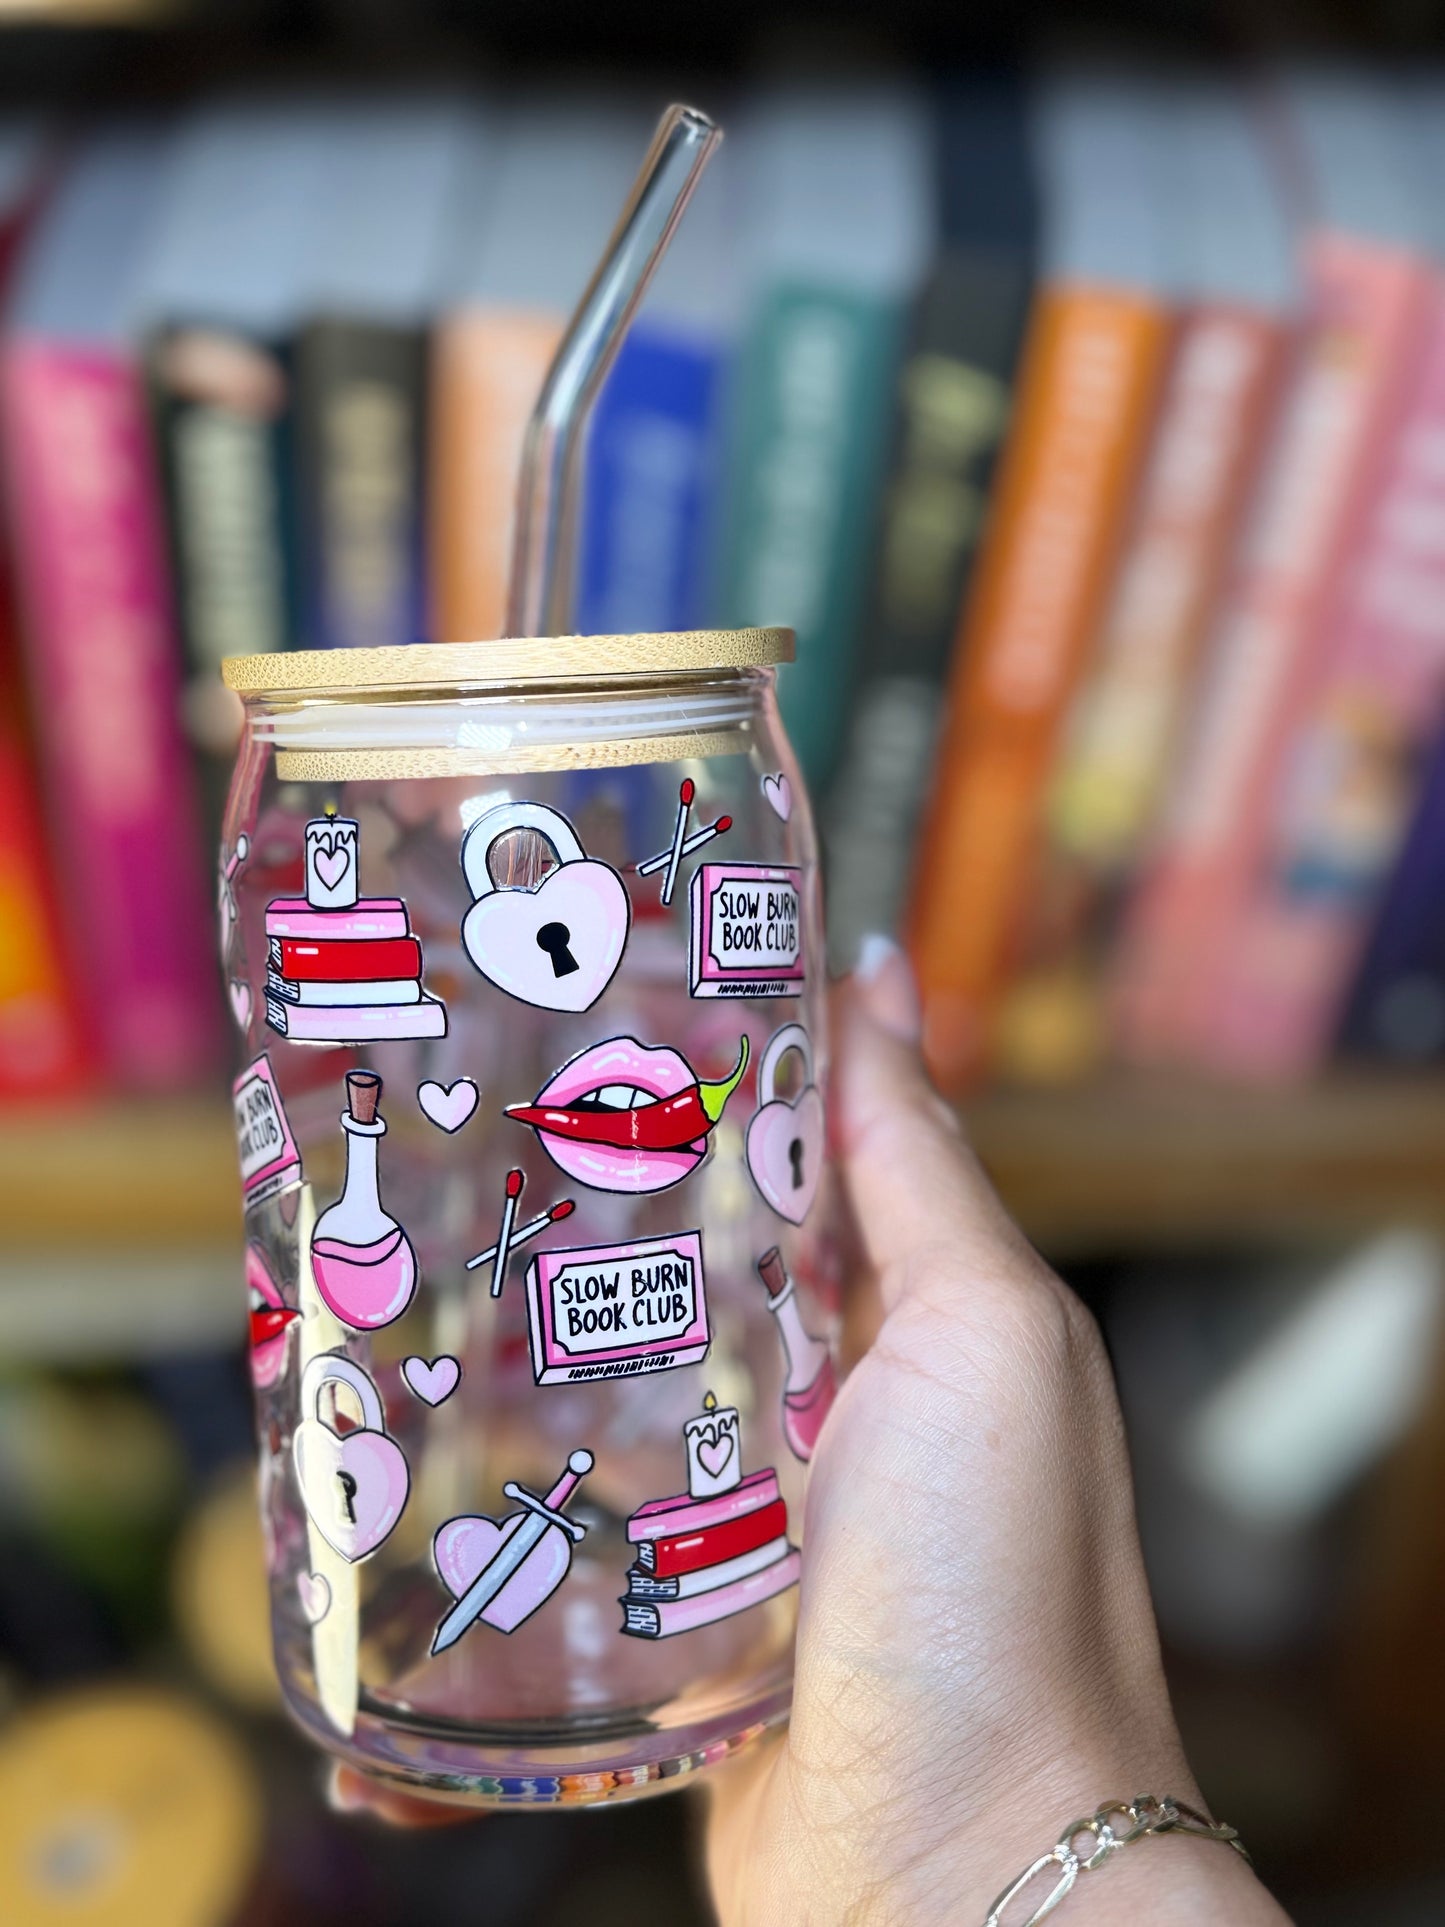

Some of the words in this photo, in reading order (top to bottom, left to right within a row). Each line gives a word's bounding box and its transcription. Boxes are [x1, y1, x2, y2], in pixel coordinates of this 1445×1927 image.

[719, 892, 760, 919] SLOW
[767, 893, 797, 921] BURN
[723, 922, 762, 952] BOOK
[766, 922, 796, 952] CLUB
[560, 1272, 619, 1304] SLOW
[631, 1262, 688, 1297] BURN
[567, 1303, 627, 1336] BOOK
[632, 1294, 687, 1326] CLUB
